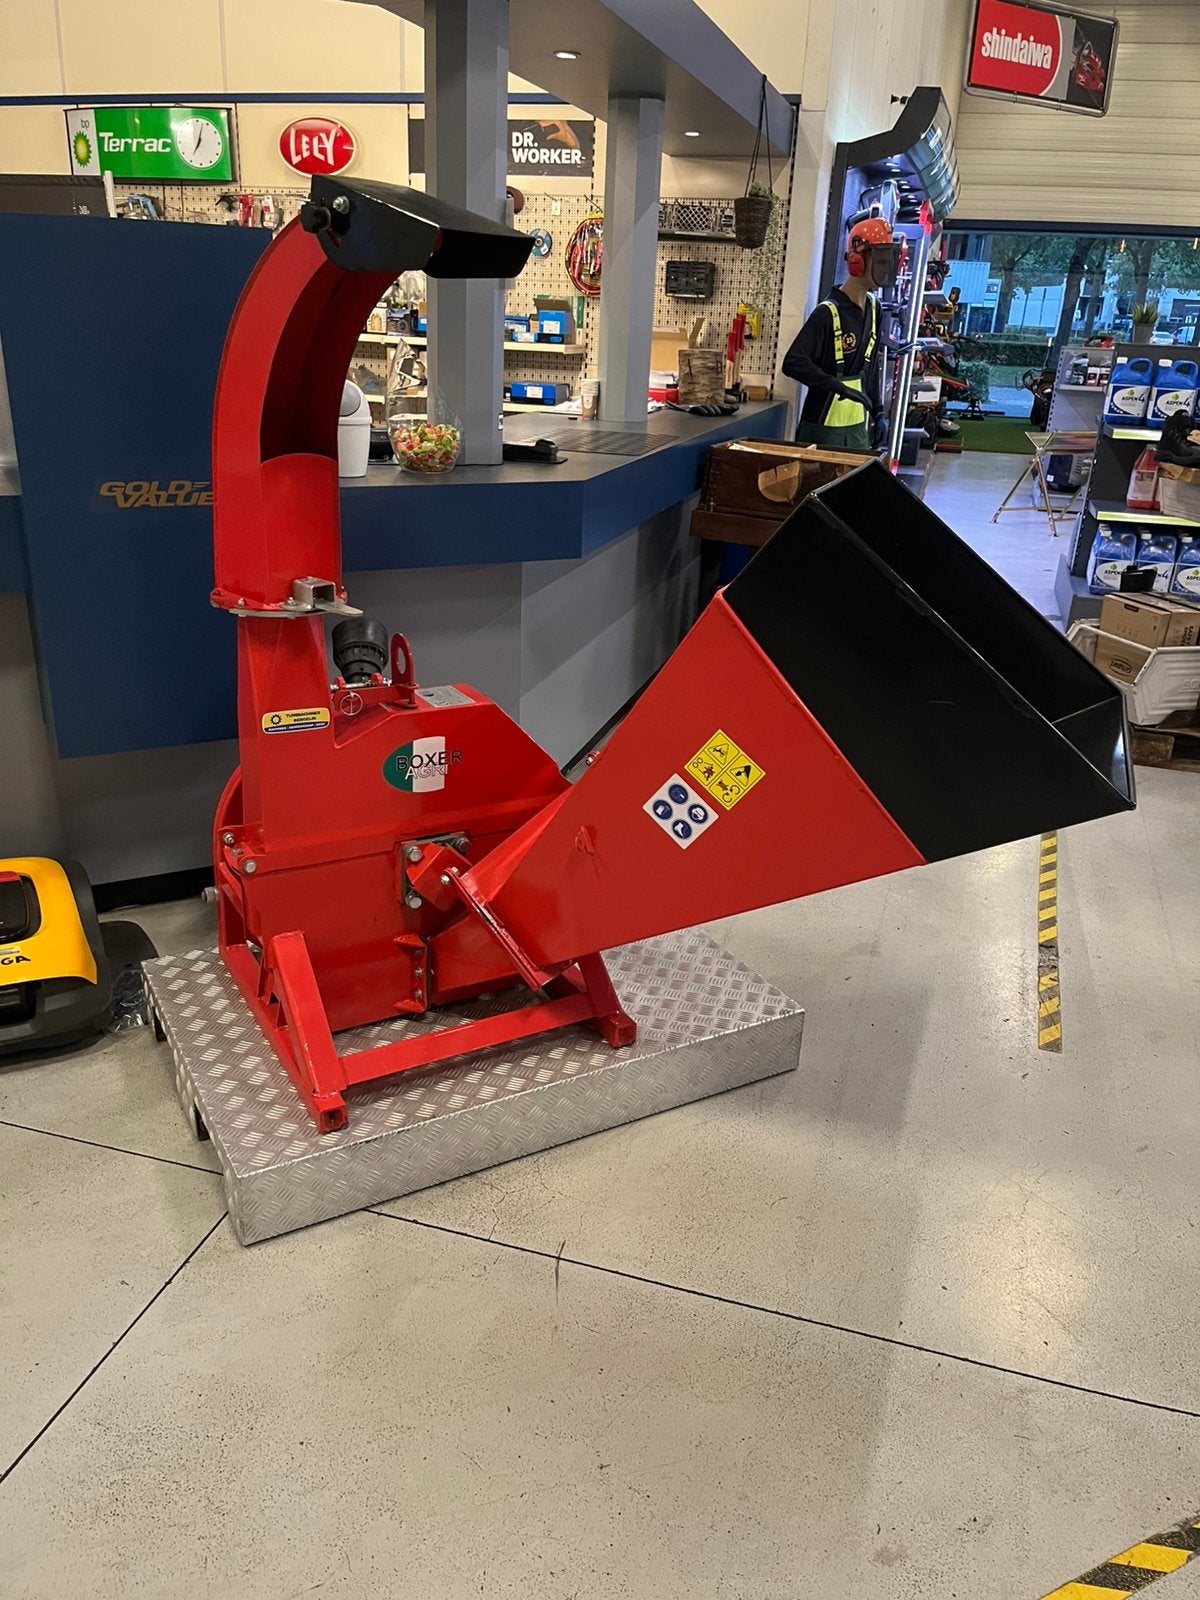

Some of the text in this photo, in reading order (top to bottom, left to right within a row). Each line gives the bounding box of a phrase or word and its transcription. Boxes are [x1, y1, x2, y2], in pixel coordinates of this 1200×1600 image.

[981, 27, 1053, 70] shindaiwa
[80, 118, 90, 129] bp
[99, 132, 172, 153] Terrac
[289, 127, 338, 167] LELY
[512, 132, 539, 148] DR.
[511, 148, 583, 165] WORKER
[1138, 393, 1146, 404] 4
[1183, 397, 1191, 408] 4
[100, 480, 193, 496] GOLD
[116, 491, 213, 507] VALUE
[396, 749, 463, 772] BOXER
[404, 763, 448, 780] AGRI
